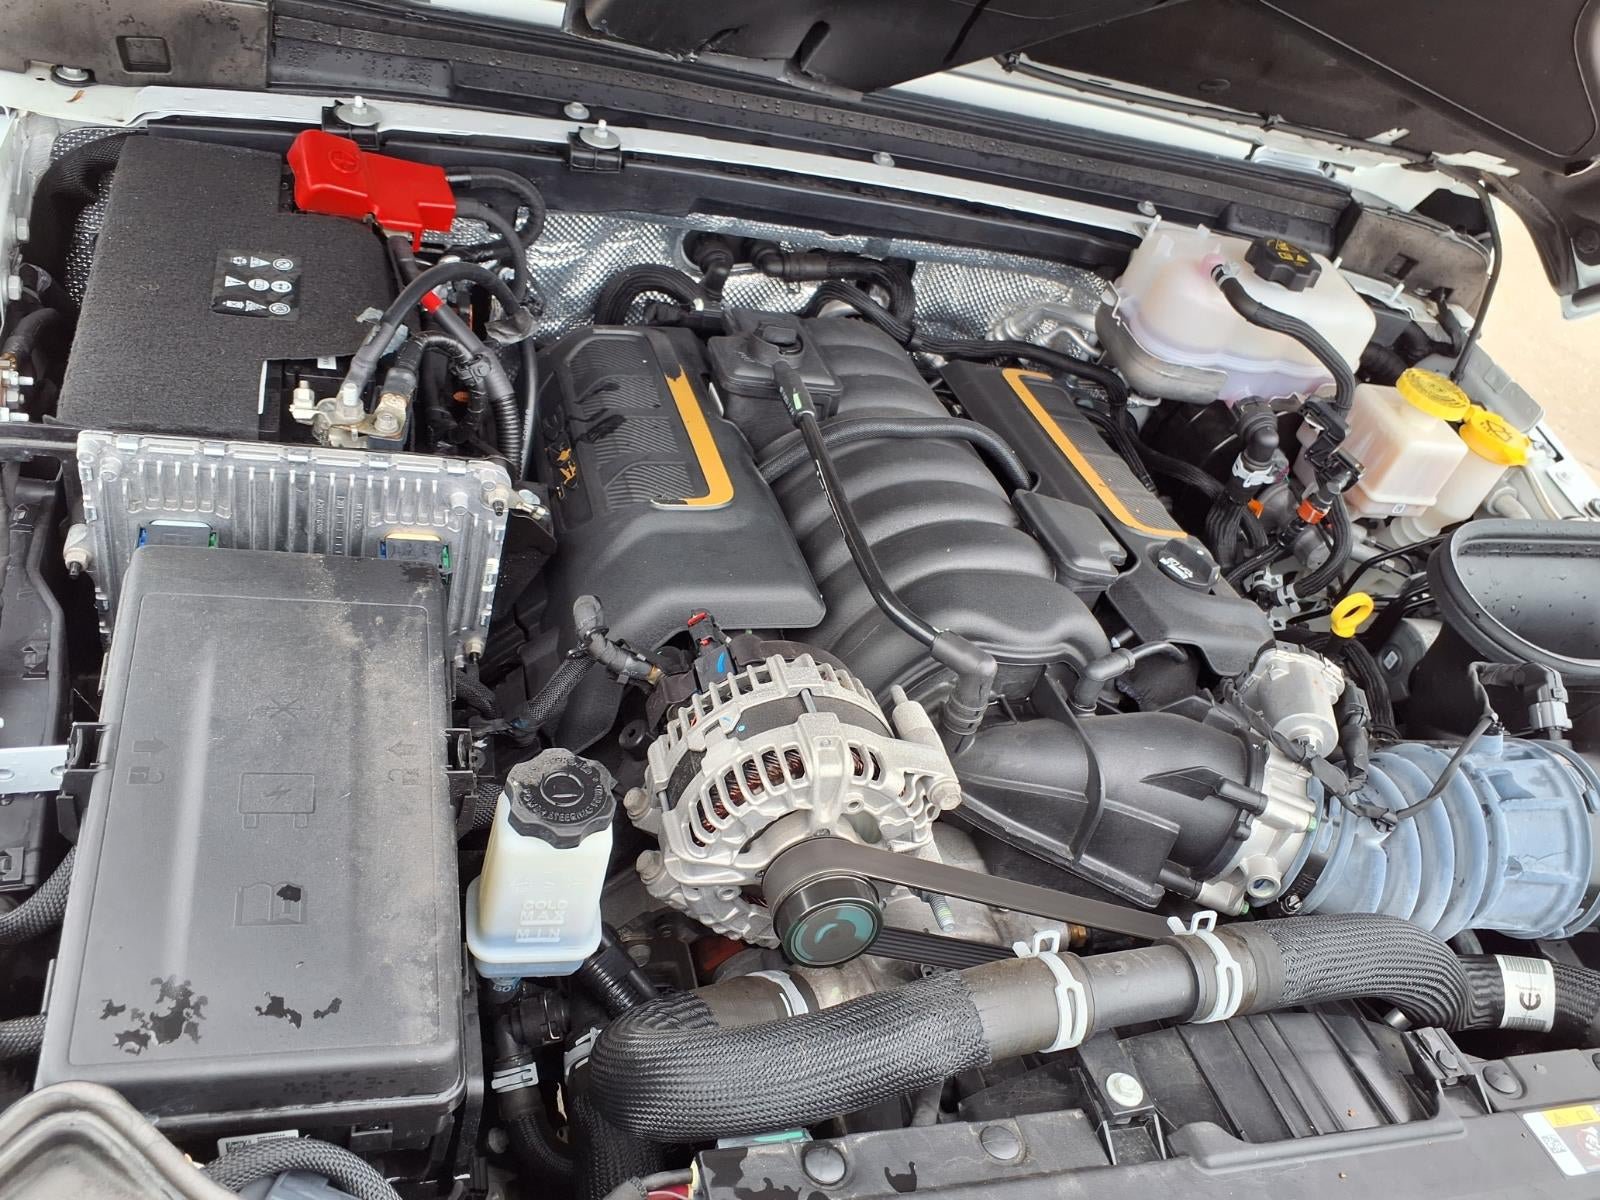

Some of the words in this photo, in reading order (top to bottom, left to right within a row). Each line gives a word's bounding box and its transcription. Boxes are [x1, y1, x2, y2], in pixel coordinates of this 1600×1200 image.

[547, 805, 594, 822] STEERING
[520, 910, 566, 921] MAX
[515, 928, 561, 939] MIN
